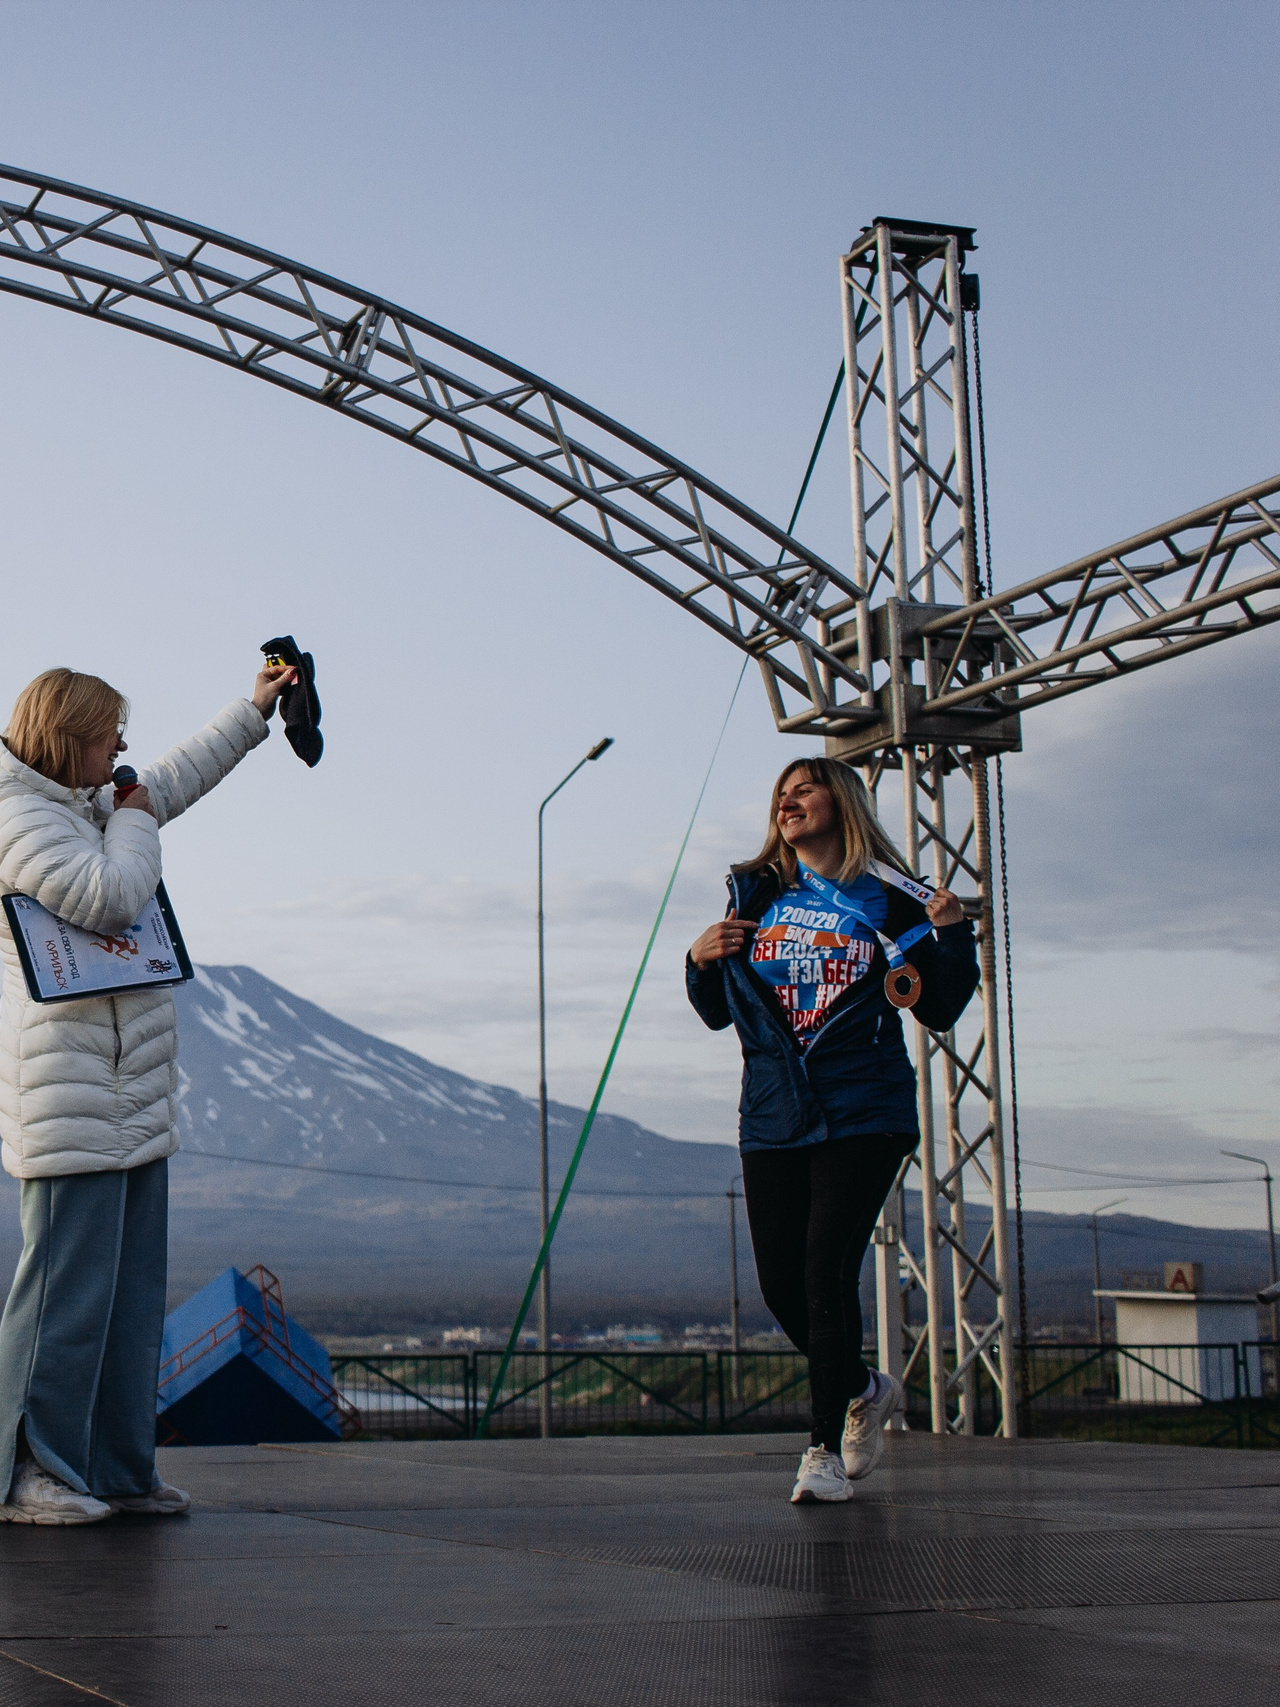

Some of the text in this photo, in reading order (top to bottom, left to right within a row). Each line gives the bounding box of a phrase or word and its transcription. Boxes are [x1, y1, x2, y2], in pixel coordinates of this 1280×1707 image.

[778, 905, 840, 930] 20029
[58, 926, 66, 935] ЗА
[62, 936, 74, 955] СВОЙ
[45, 940, 68, 990] КУРИЛЬСК
[67, 956, 80, 979] ГОРОД
